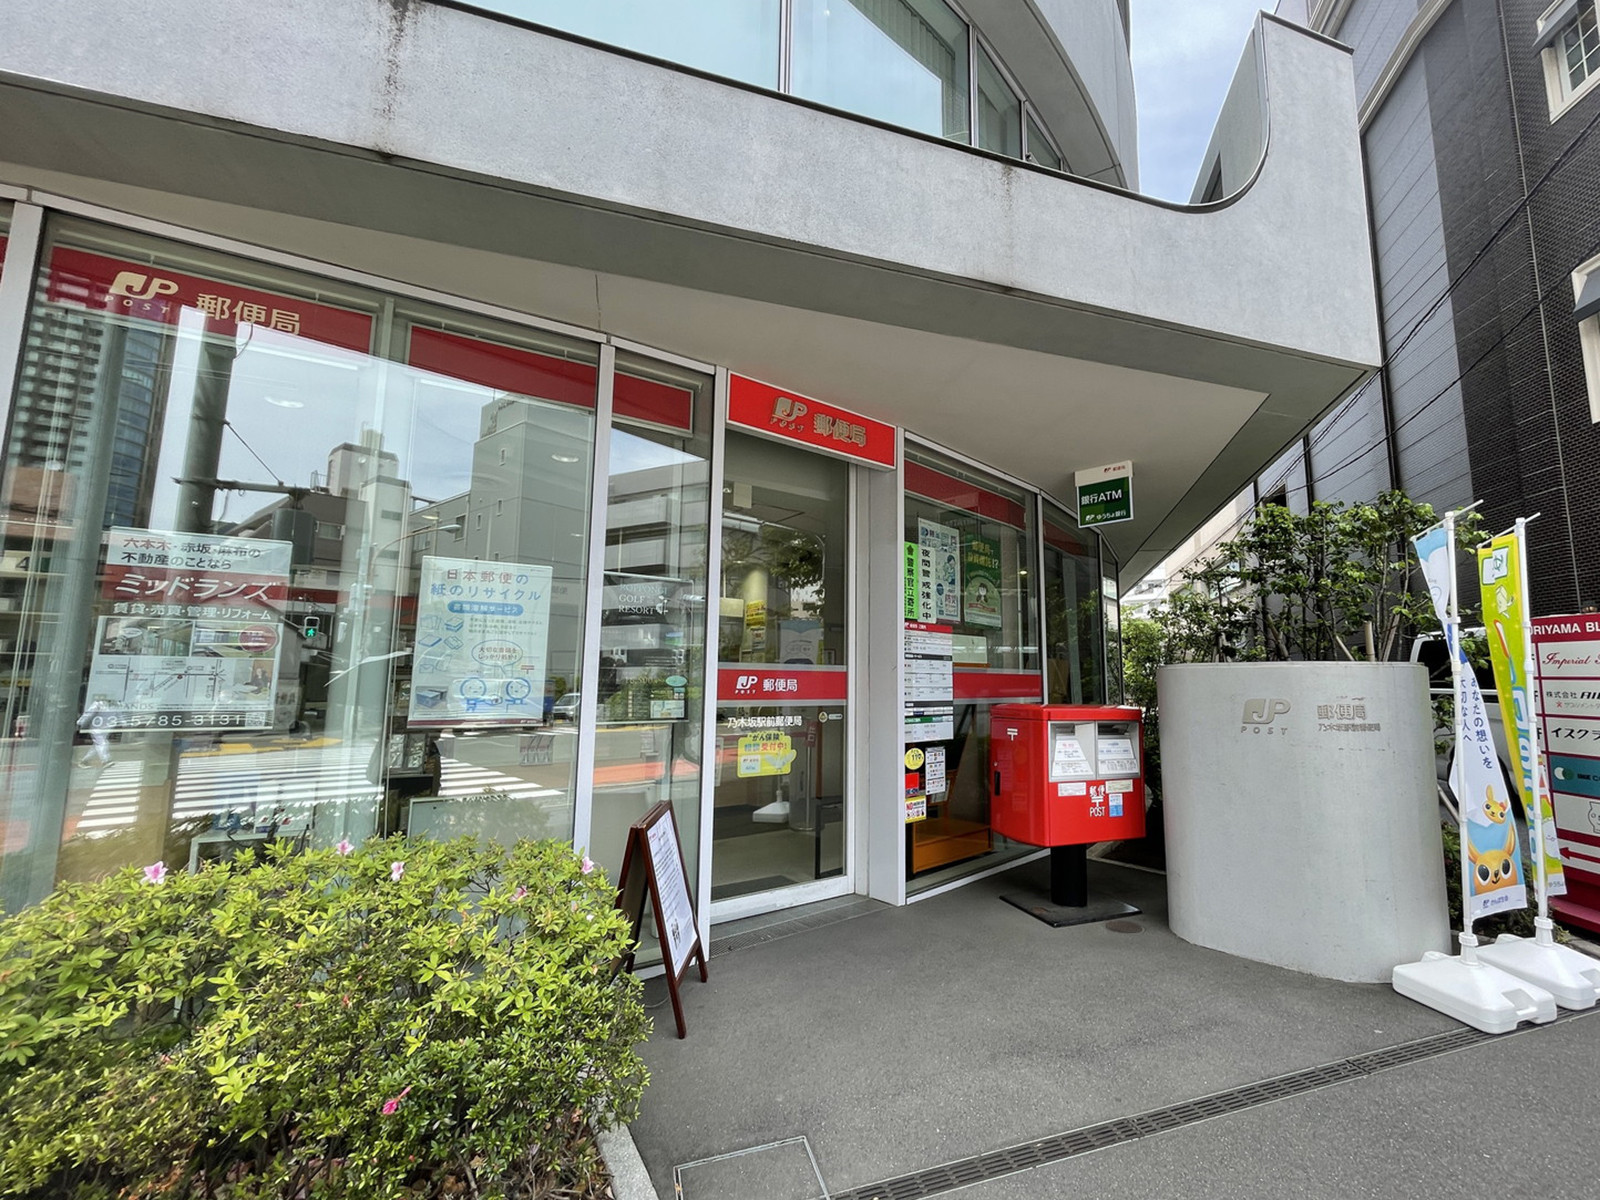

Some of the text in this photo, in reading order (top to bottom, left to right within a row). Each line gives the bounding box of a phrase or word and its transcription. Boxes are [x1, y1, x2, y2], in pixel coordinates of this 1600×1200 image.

[109, 271, 179, 300] JP
[104, 295, 170, 315] POST
[196, 293, 301, 336] 郵便局
[774, 396, 808, 422] JP
[770, 417, 804, 432] POST
[814, 413, 867, 447] 郵便局
[1081, 489, 1123, 506] 銀行ATM
[1096, 510, 1127, 520] ゆうちょ銀行
[121, 552, 232, 570] 不動産のことなら
[447, 569, 529, 585] 日本郵便の
[115, 573, 277, 601] ミッドランズ
[430, 583, 541, 601] 紙のリサイクル
[618, 594, 646, 603] GOLF
[618, 604, 654, 615] RESORT
[1542, 651, 1591, 670] Imperial
[736, 675, 758, 690] JP
[763, 678, 798, 692] 郵便局
[1546, 691, 1577, 699] 株式会社
[1242, 698, 1291, 725] JP
[1317, 703, 1367, 720] 郵便局
[727, 715, 802, 728] 乃木坂駅前郵便局
[1240, 726, 1288, 735] POST
[1089, 806, 1105, 817] POST
